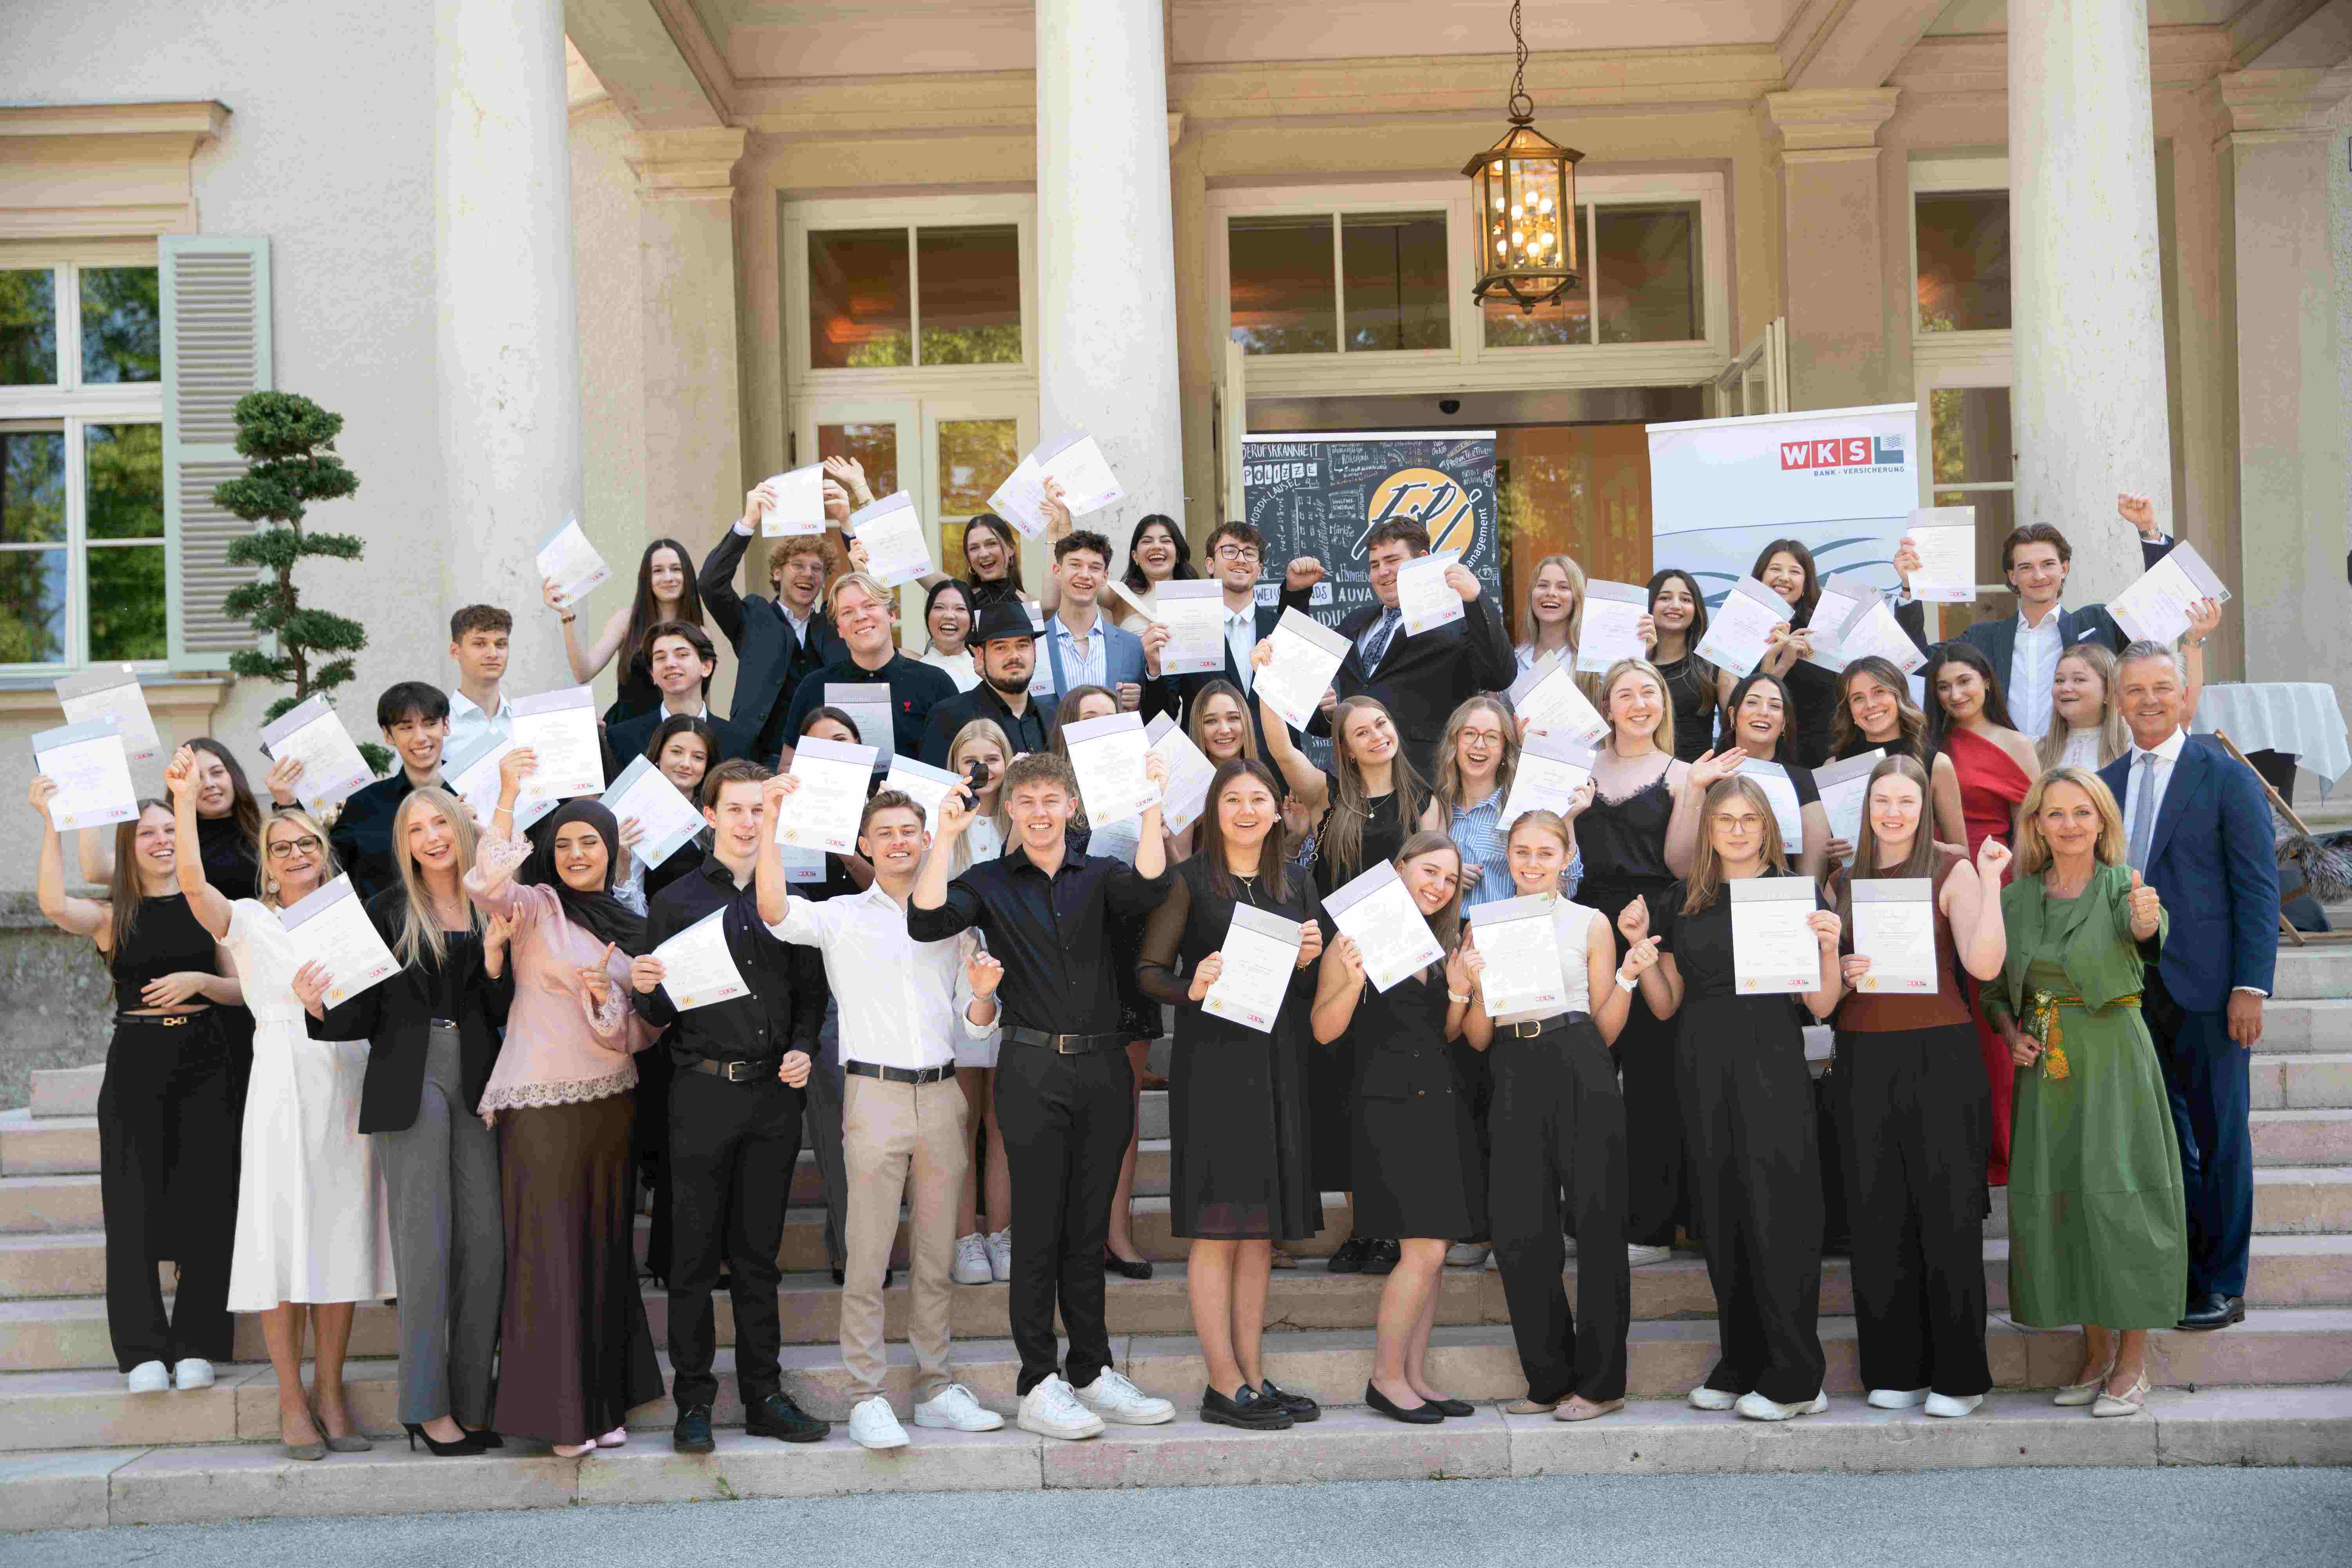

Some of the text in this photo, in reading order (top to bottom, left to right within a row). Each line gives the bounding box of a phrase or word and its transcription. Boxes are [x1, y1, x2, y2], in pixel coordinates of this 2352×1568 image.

[1244, 463, 1317, 485] POLIZZE
[1844, 466, 1905, 475] VERSICHERUNG
[1329, 523, 1355, 537] Märkte
[1338, 587, 1373, 602] AUVA
